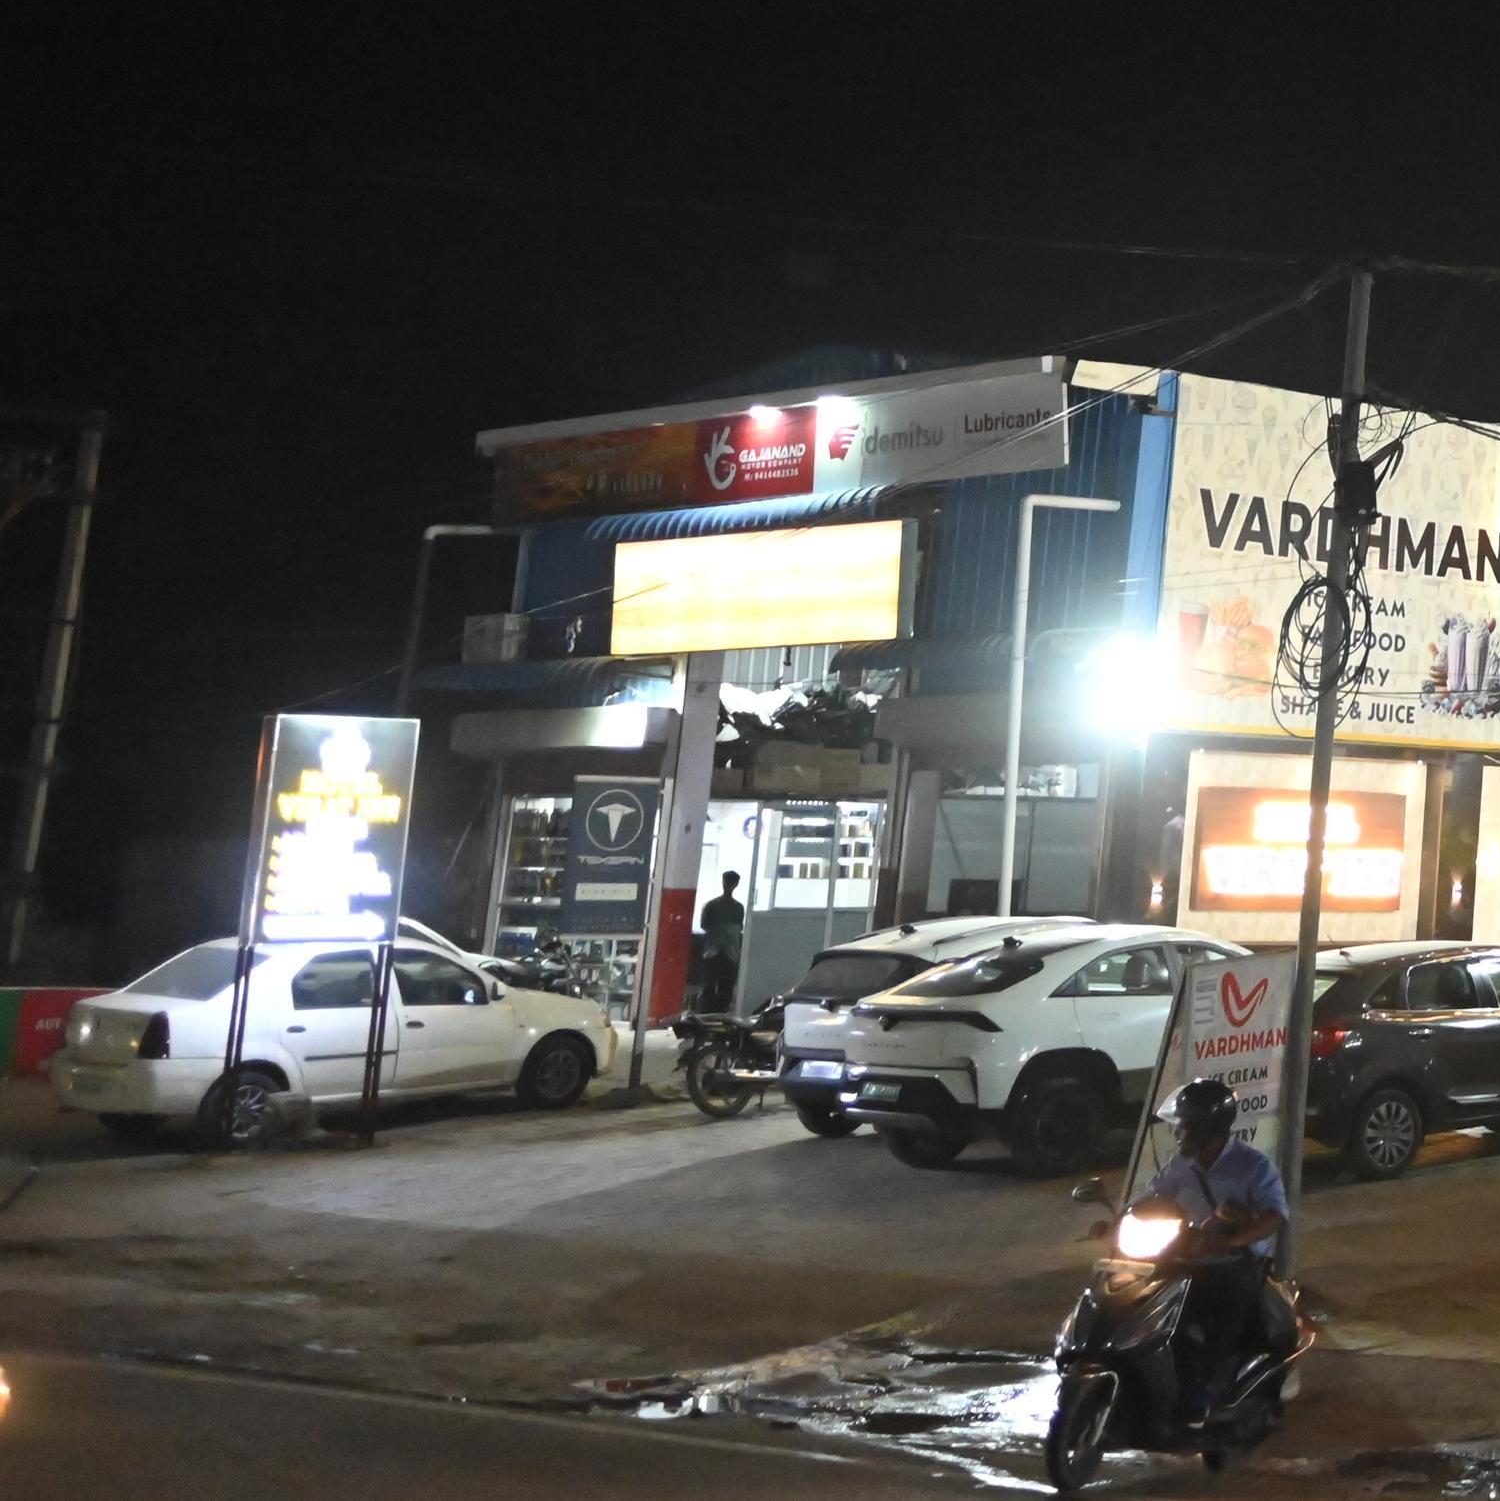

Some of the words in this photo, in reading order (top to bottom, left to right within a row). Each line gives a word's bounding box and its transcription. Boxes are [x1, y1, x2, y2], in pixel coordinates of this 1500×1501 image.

[965, 409, 1050, 434] Lubricants
[739, 443, 806, 463] GAJANAND
[1342, 592, 1406, 618] REAM
[1313, 662, 1390, 687] BKRY
[1280, 695, 1344, 719] SHAE
[1368, 702, 1416, 724] JUICE
[1195, 1026, 1287, 1060] VARDHMAN
[1228, 1065, 1269, 1085] CREAM
[1236, 1094, 1268, 1113] OOD
